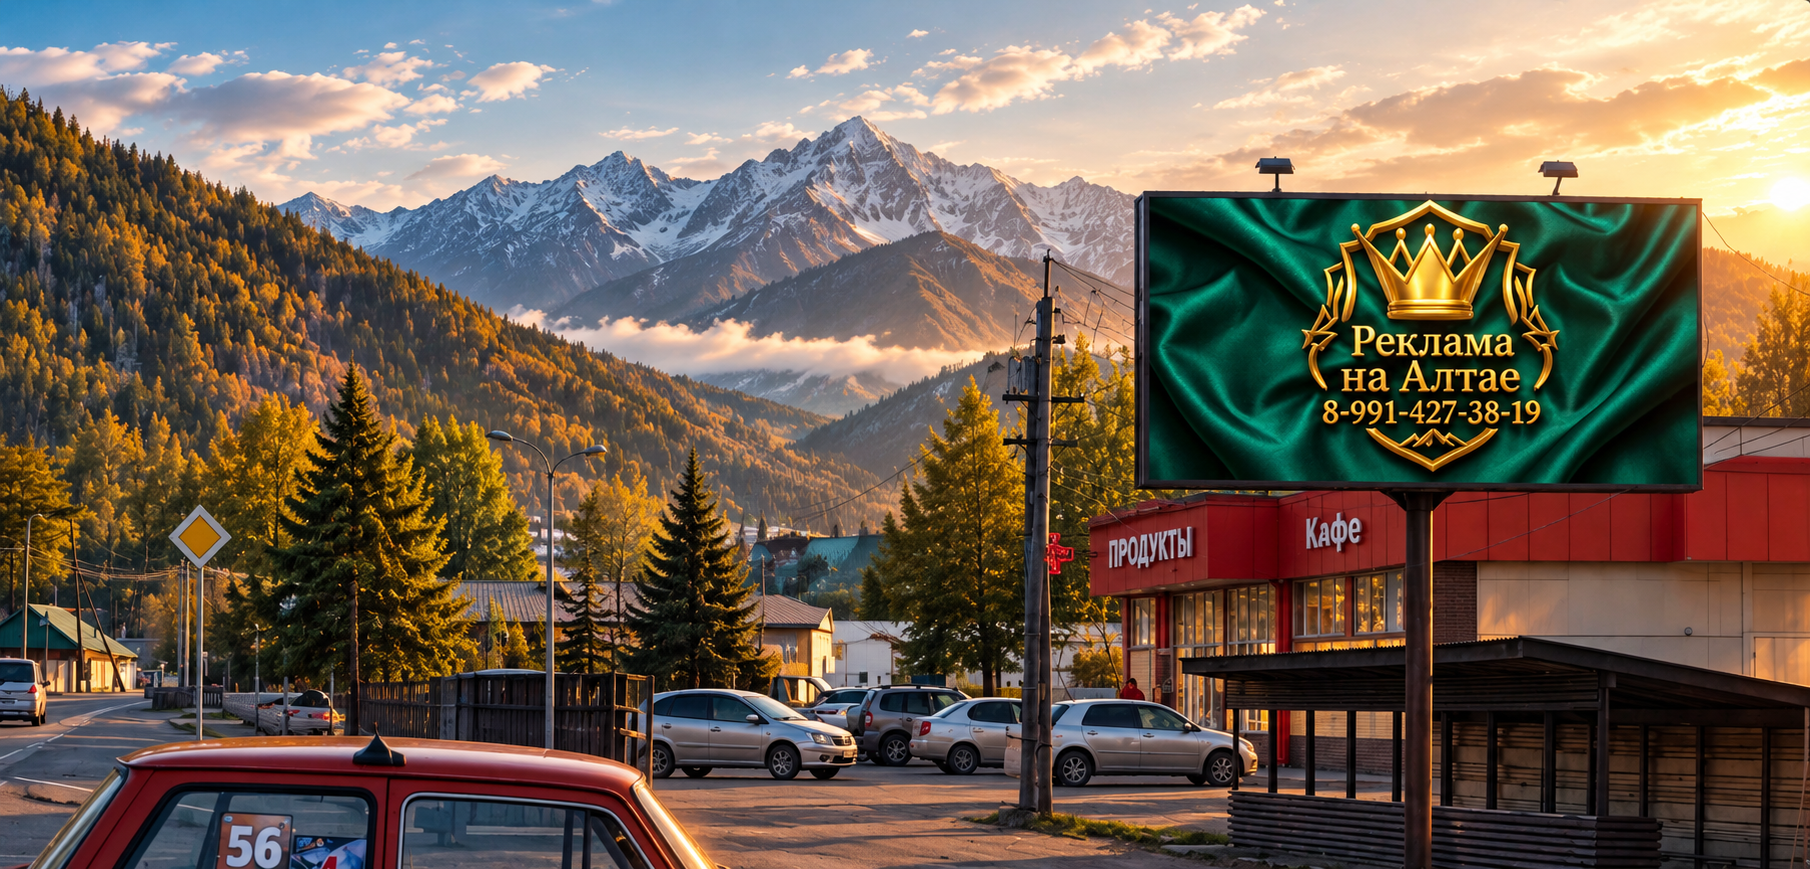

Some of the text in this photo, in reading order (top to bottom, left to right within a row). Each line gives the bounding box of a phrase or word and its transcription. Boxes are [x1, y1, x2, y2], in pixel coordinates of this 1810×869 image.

[1351, 325, 1515, 357] Реклама
[1341, 360, 1521, 392] на Алтае
[1322, 400, 1541, 424] 8-991-427-38-19
[1109, 526, 1193, 569] ПРОДУКТЫ
[1306, 512, 1361, 553] Кафе
[226, 825, 282, 869] 56
